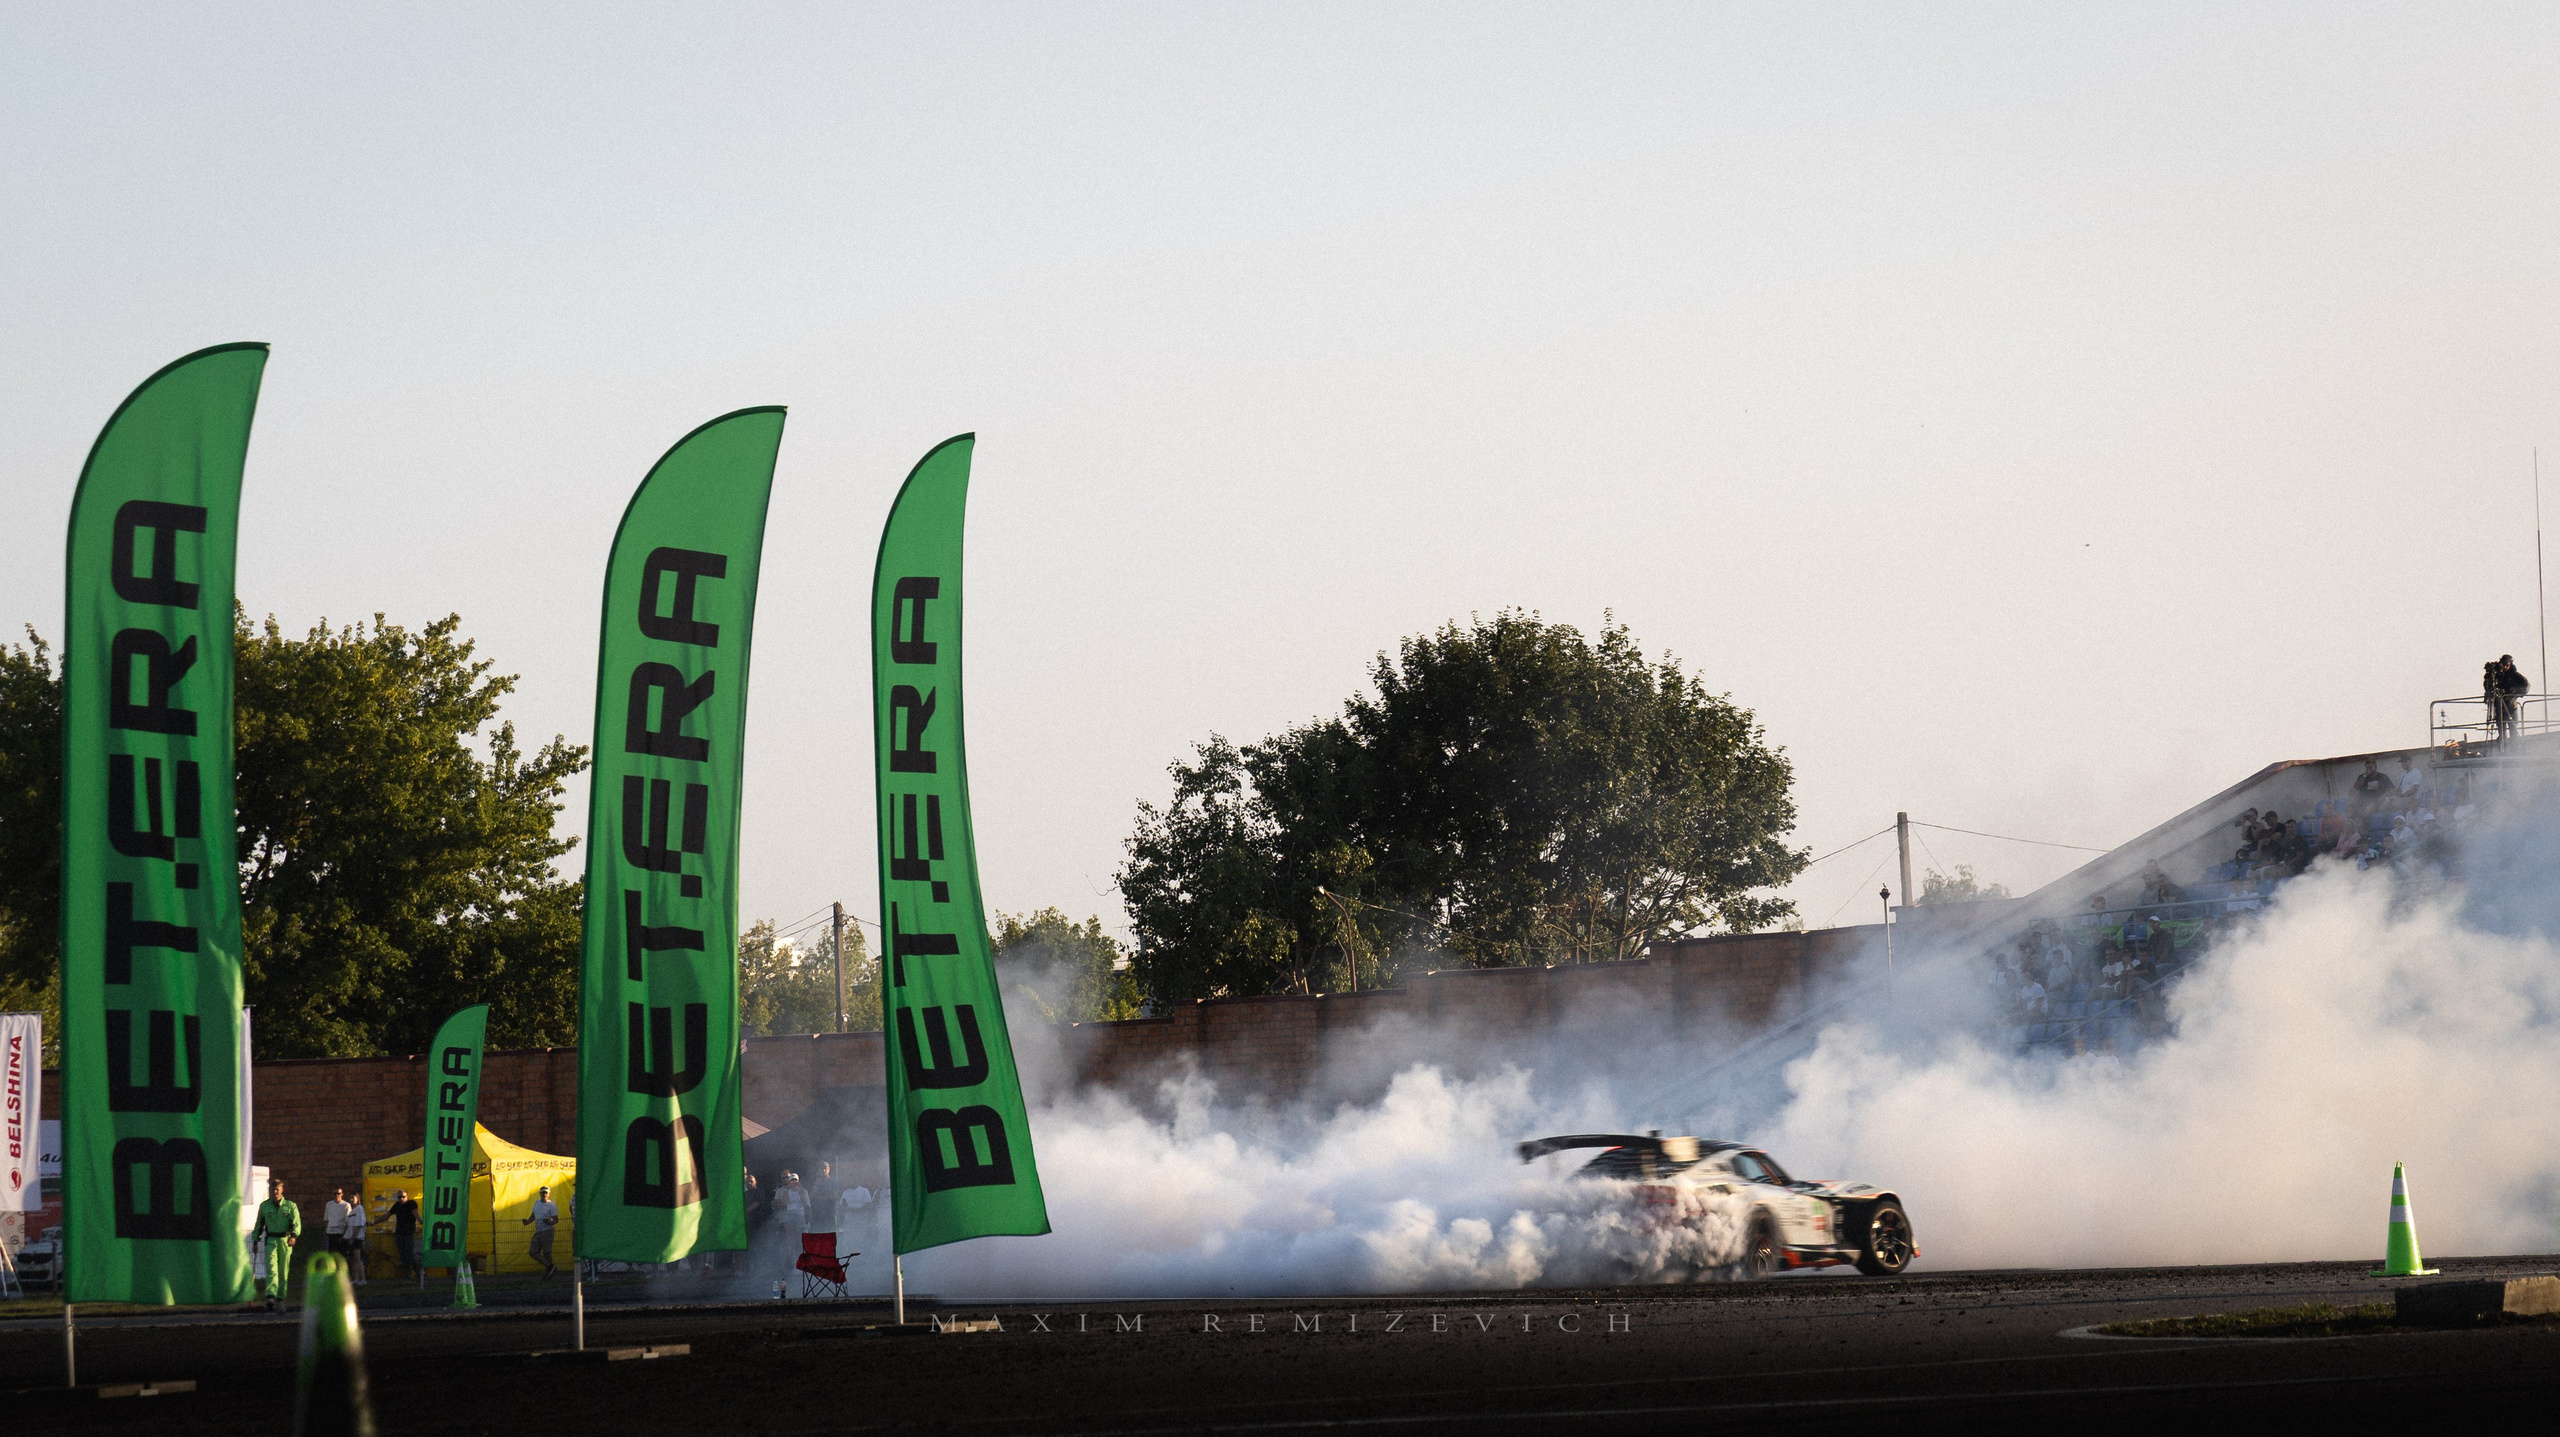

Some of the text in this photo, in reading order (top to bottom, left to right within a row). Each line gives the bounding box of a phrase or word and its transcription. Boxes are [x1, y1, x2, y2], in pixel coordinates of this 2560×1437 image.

[7, 1036, 22, 1158] BELSHINA
[368, 1165, 383, 1175] AIR
[383, 1164, 406, 1175] SHOP
[471, 1162, 487, 1173] HOP
